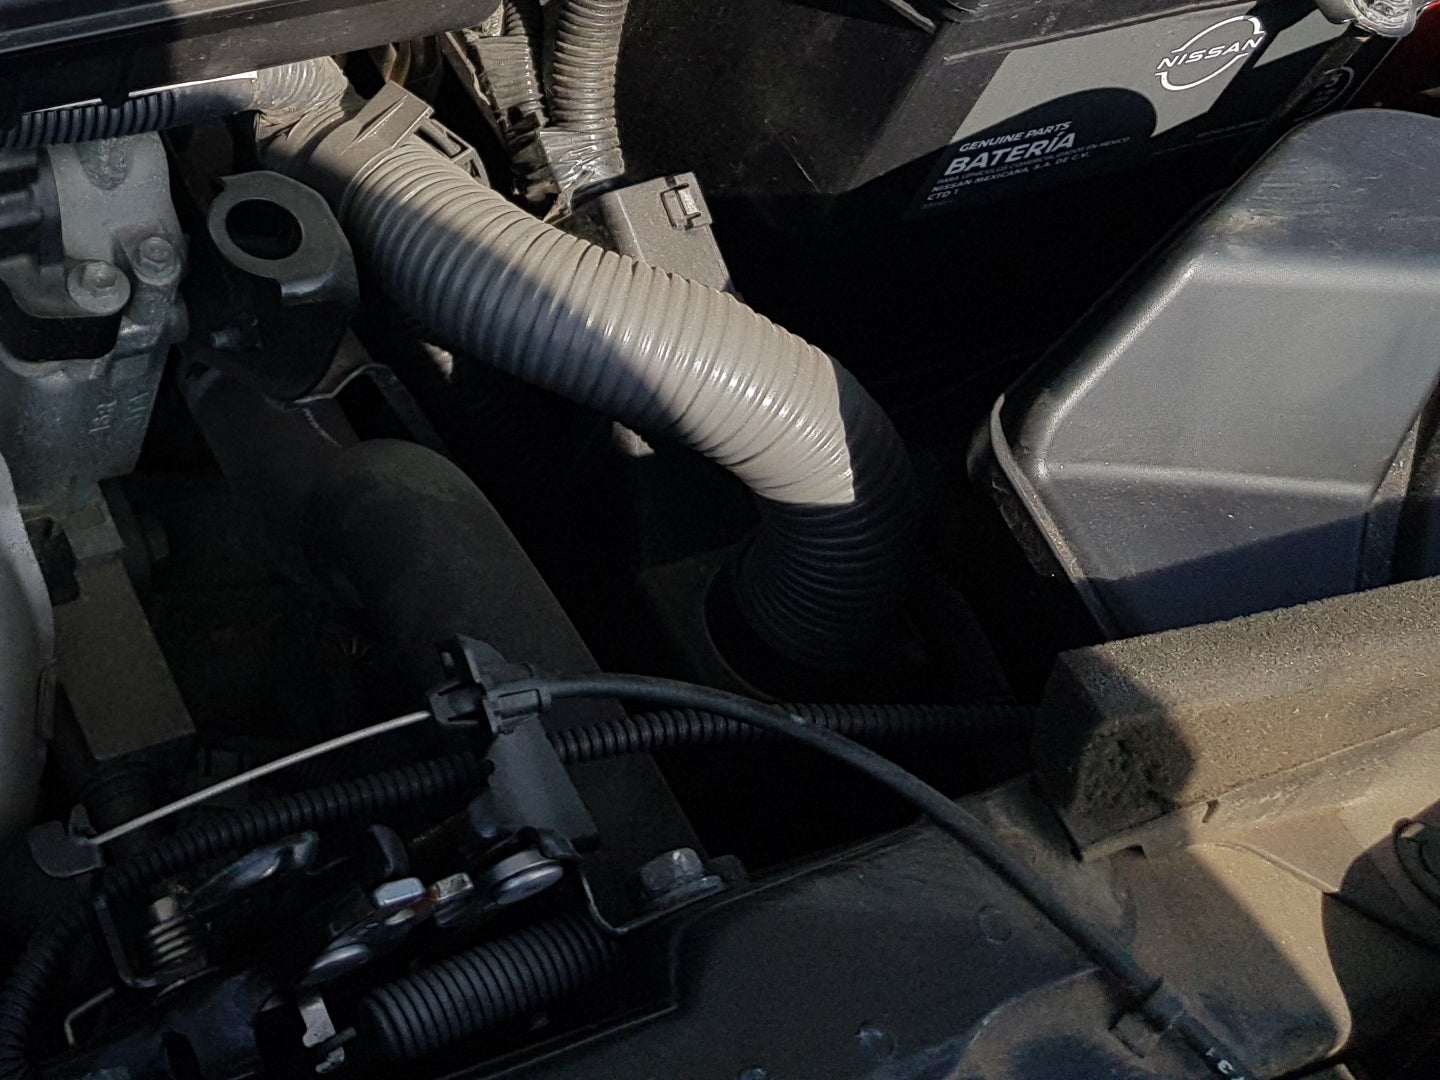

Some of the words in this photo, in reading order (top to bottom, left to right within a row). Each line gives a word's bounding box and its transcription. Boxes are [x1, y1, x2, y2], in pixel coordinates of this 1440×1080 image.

[1157, 37, 1264, 70] NISSAN
[959, 131, 1024, 152] GENUINE
[1025, 121, 1072, 138] PARTS
[943, 131, 1077, 177] BATERÍA
[931, 178, 972, 193] NISSAN
